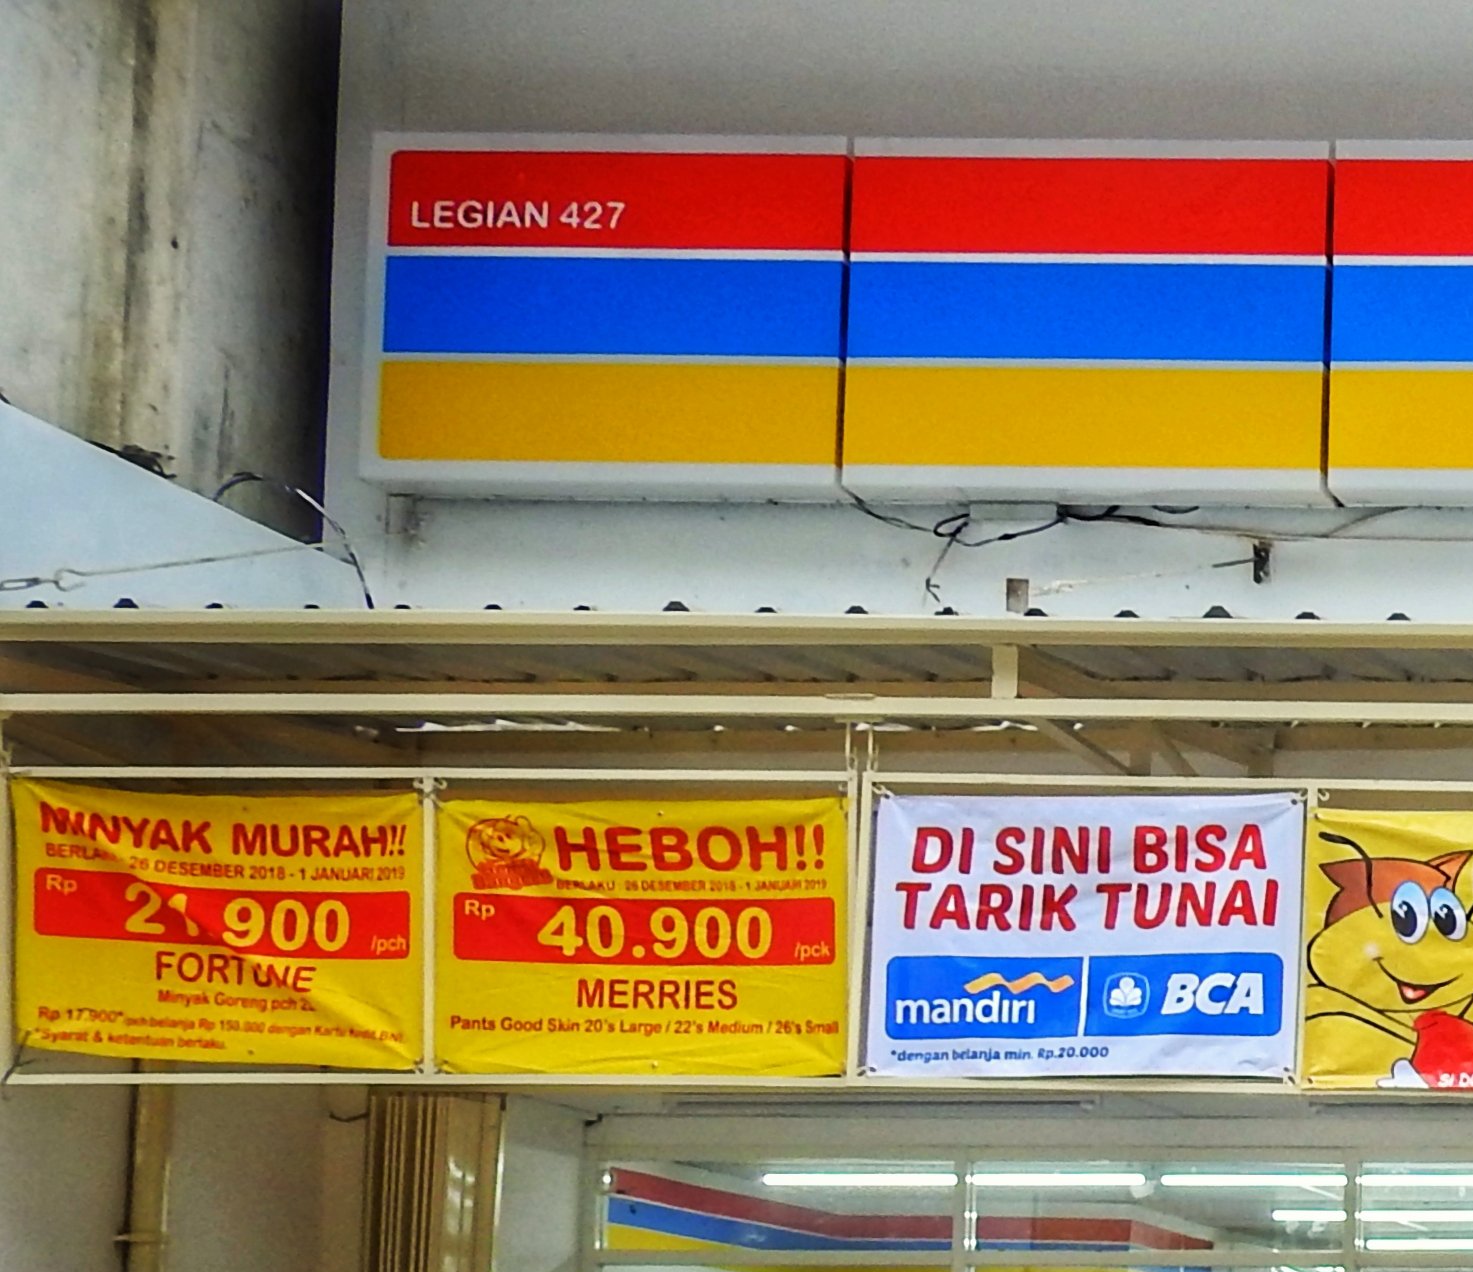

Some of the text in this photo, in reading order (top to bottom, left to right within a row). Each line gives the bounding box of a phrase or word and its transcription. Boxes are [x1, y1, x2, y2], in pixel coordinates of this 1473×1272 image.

[410, 200, 626, 229] LEGIAN 427
[39, 801, 407, 858] MINYAK MURAH!!
[554, 824, 826, 872] HEBOH!!
[911, 824, 1268, 875] DI SINI BISA
[46, 874, 78, 895] Rp
[154, 859, 245, 880] DESEMBER
[249, 865, 286, 881] 2018
[310, 867, 374, 882] JANUARI
[464, 900, 495, 919] Rp
[896, 879, 1279, 931] TARIK TUNAI
[537, 905, 831, 959] 40.900 /pck
[155, 951, 317, 993] FORTUNE
[577, 978, 738, 1011] MERRIES
[895, 972, 1264, 1025] mandiri BCA
[450, 1016, 496, 1032] Pants
[500, 1017, 543, 1033] Good
[547, 1017, 580, 1033] Skin
[619, 1019, 662, 1036] Large
[708, 1020, 763, 1034] Medium
[952, 1048, 1001, 1062] belanja
[1004, 1048, 1034, 1060] min.
